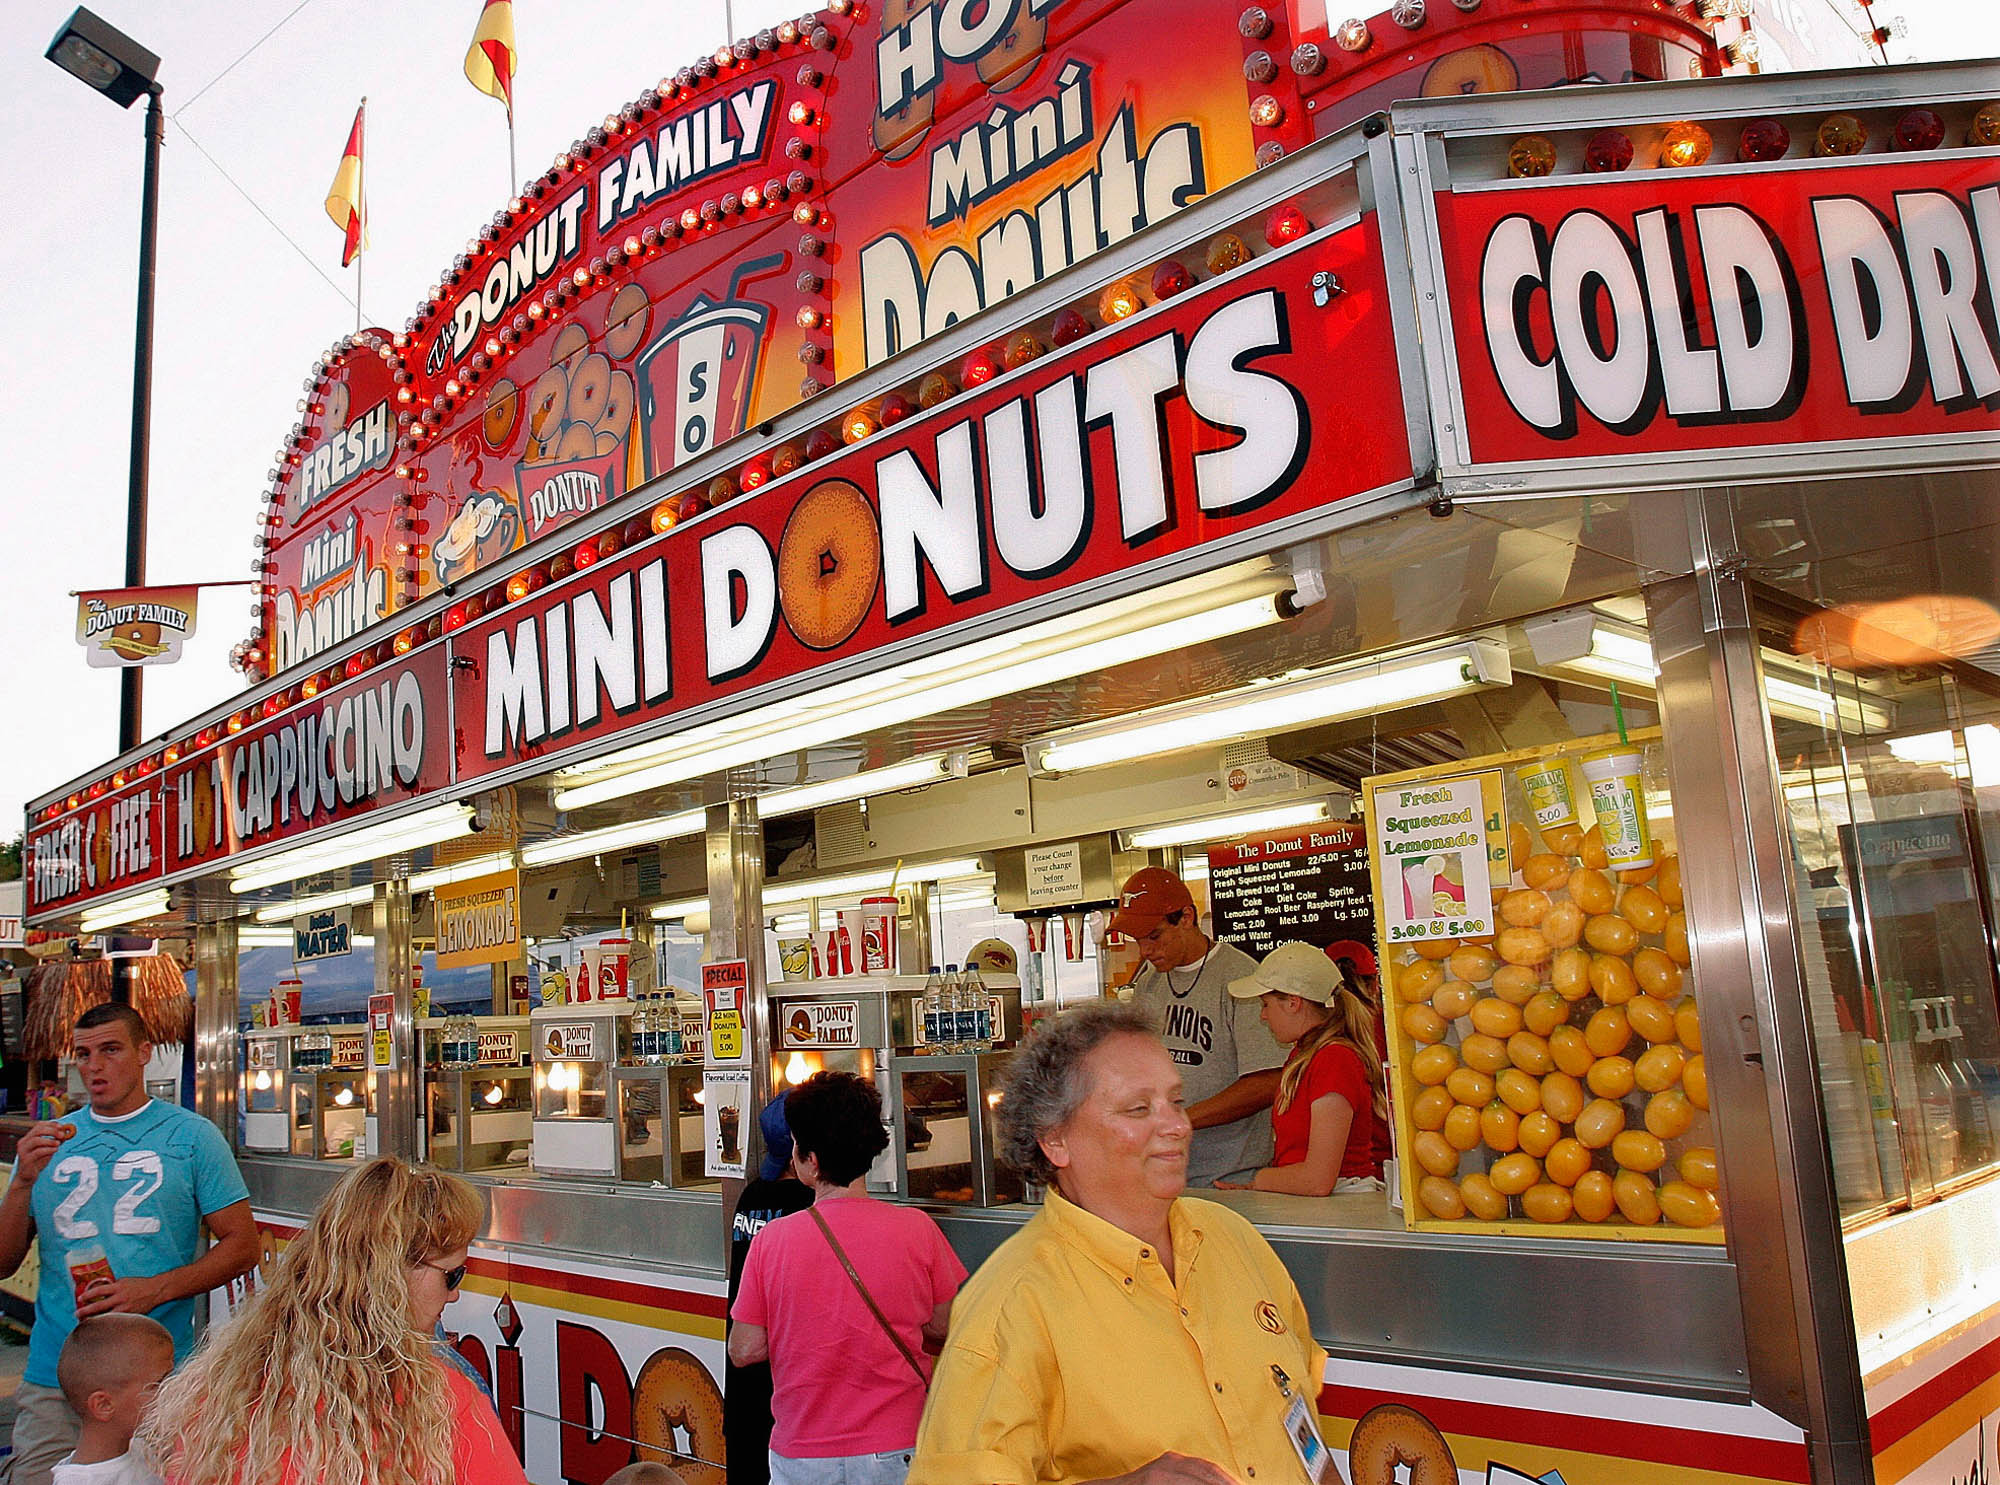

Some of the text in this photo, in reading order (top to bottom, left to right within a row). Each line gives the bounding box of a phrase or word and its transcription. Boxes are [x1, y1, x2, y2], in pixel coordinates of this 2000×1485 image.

[877, 0, 1052, 115] HO
[927, 62, 1086, 222] Mini
[427, 81, 777, 377] The DONUT FAMILY
[1481, 203, 1803, 434] COLD
[300, 400, 390, 510] FRESH
[529, 470, 601, 533] DONUT
[484, 290, 1306, 761] MINI DONUTS
[300, 514, 356, 590] Mini
[87, 600, 106, 612] The
[86, 604, 188, 637] DONUT FAMILY
[34, 669, 425, 906] FRESH COFFEE HOT CAPPUCCINO
[1229, 774, 1247, 786] STOP
[1399, 786, 1453, 808] Fresh
[1385, 807, 1473, 834] Squeezed
[1536, 808, 1561, 824] 3.00
[1234, 828, 1354, 858] The Donut Family
[1383, 831, 1479, 856] Lemonade
[1031, 850, 1073, 862] Please Count
[1212, 866, 1242, 878] Original
[1243, 863, 1260, 873] Mini
[1262, 860, 1291, 871] Donuts
[1307, 852, 1339, 866] 22/5.00
[1033, 862, 1072, 875] your change
[1042, 874, 1064, 883] before
[1213, 878, 1236, 889] Fresh
[1238, 872, 1277, 886] Squeezed
[1278, 866, 1321, 880] Lemonade
[443, 888, 504, 912] FRESH SQUEEZED
[1029, 883, 1079, 896] leaving counter
[1214, 882, 1295, 899] Fresh Brewed Iced Tea
[1242, 886, 1355, 907] Coke Diet Coke Sprite
[1224, 908, 1260, 919] Lemonade
[1264, 906, 1282, 915] Root
[1283, 904, 1301, 913] Beer
[1306, 899, 1345, 910] Raspberry
[1347, 896, 1365, 906] Iced
[434, 886, 516, 955] LEMONADE
[1232, 907, 1369, 931] Sm. 2.00 Med. 3.00 Lg. 5.00
[1391, 919, 1485, 940] 3.00 & 5.00
[296, 922, 349, 958] WATER
[1218, 931, 1272, 944] Bottled Water
[1256, 941, 1274, 951] Iced
[705, 966, 743, 984] SPECIAL
[714, 1012, 722, 1020] 22
[815, 1005, 854, 1024] DONUT
[566, 1026, 592, 1041] DONUT
[713, 1022, 737, 1030] DONUTS
[816, 1025, 854, 1043] FAMILY
[479, 1035, 513, 1047] DONUT
[566, 1043, 591, 1057] FAMILY
[719, 1043, 734, 1051] 5.00
[53, 1150, 164, 1240] 22
